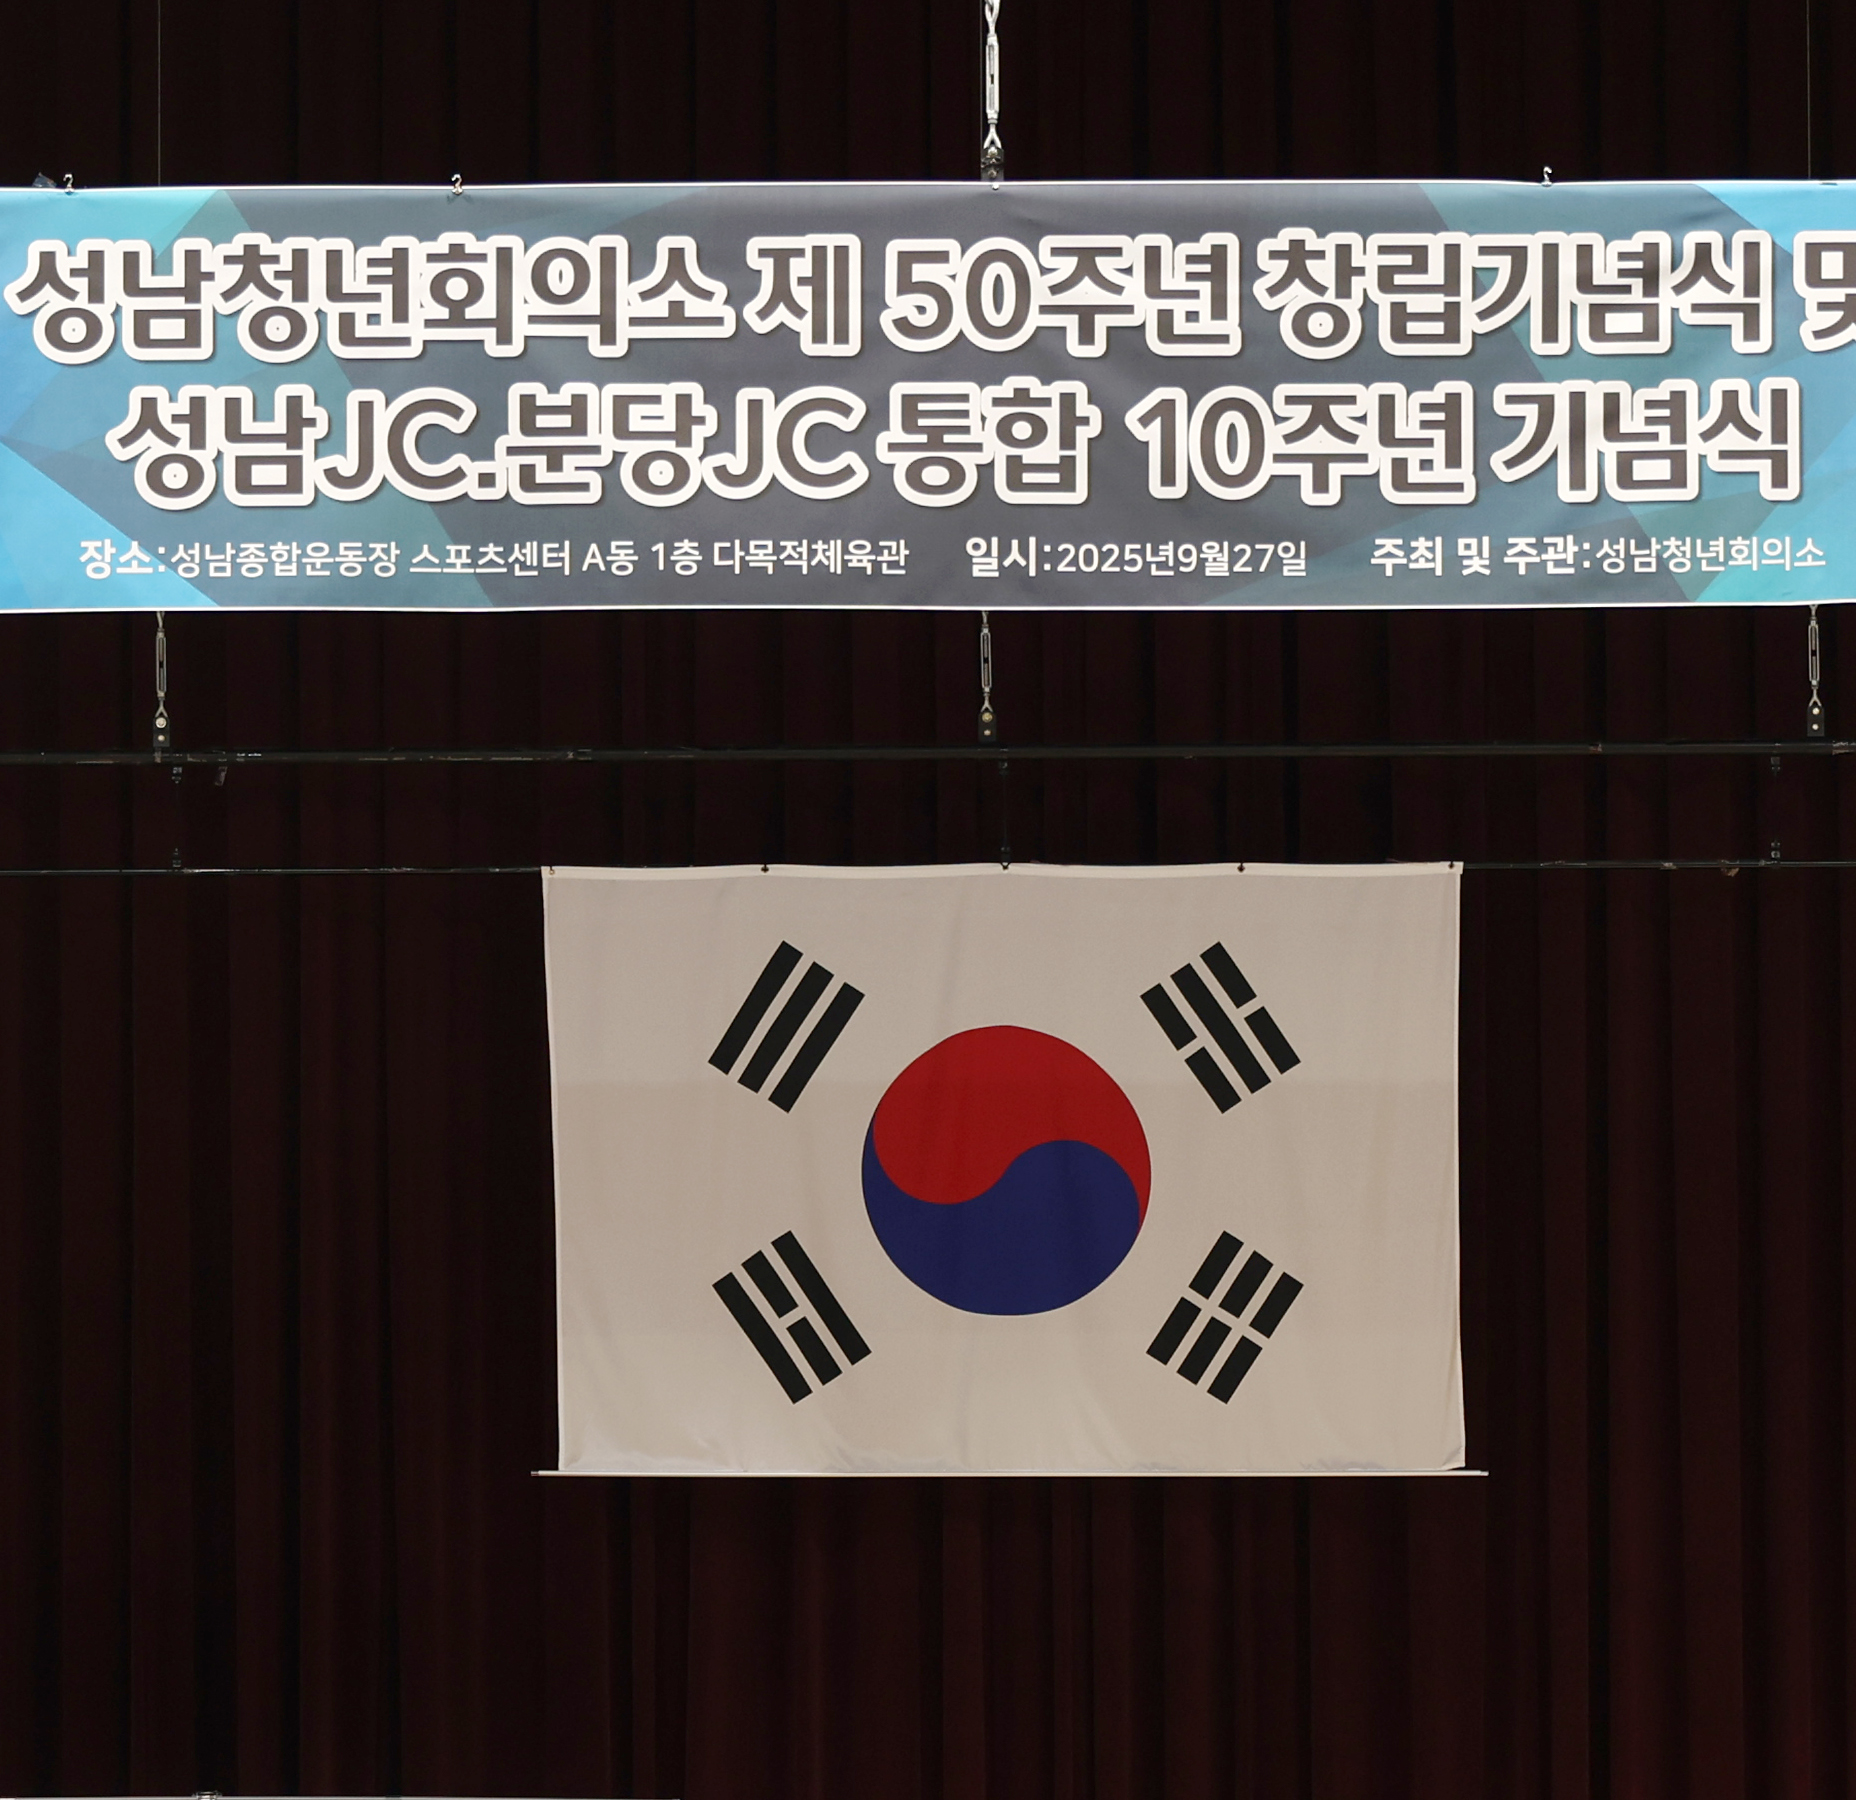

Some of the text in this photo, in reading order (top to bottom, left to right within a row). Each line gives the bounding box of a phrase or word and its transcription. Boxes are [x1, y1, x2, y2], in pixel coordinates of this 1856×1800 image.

[10, 238, 734, 356] 성남청년회의소
[754, 238, 854, 350] 제
[891, 236, 1239, 350] 50주년
[1256, 232, 1768, 354] 창립기념식
[110, 380, 1797, 503] 성남JC.분당JC 통합 10주년 기념식
[79, 536, 911, 580] 장소:성남종합운동장 스포츠센터 A동 1층 다목적체육관
[965, 534, 1309, 580] 일시:2025년9월27일
[1370, 534, 1828, 580] 주최 및 주관:성남청년회의소
